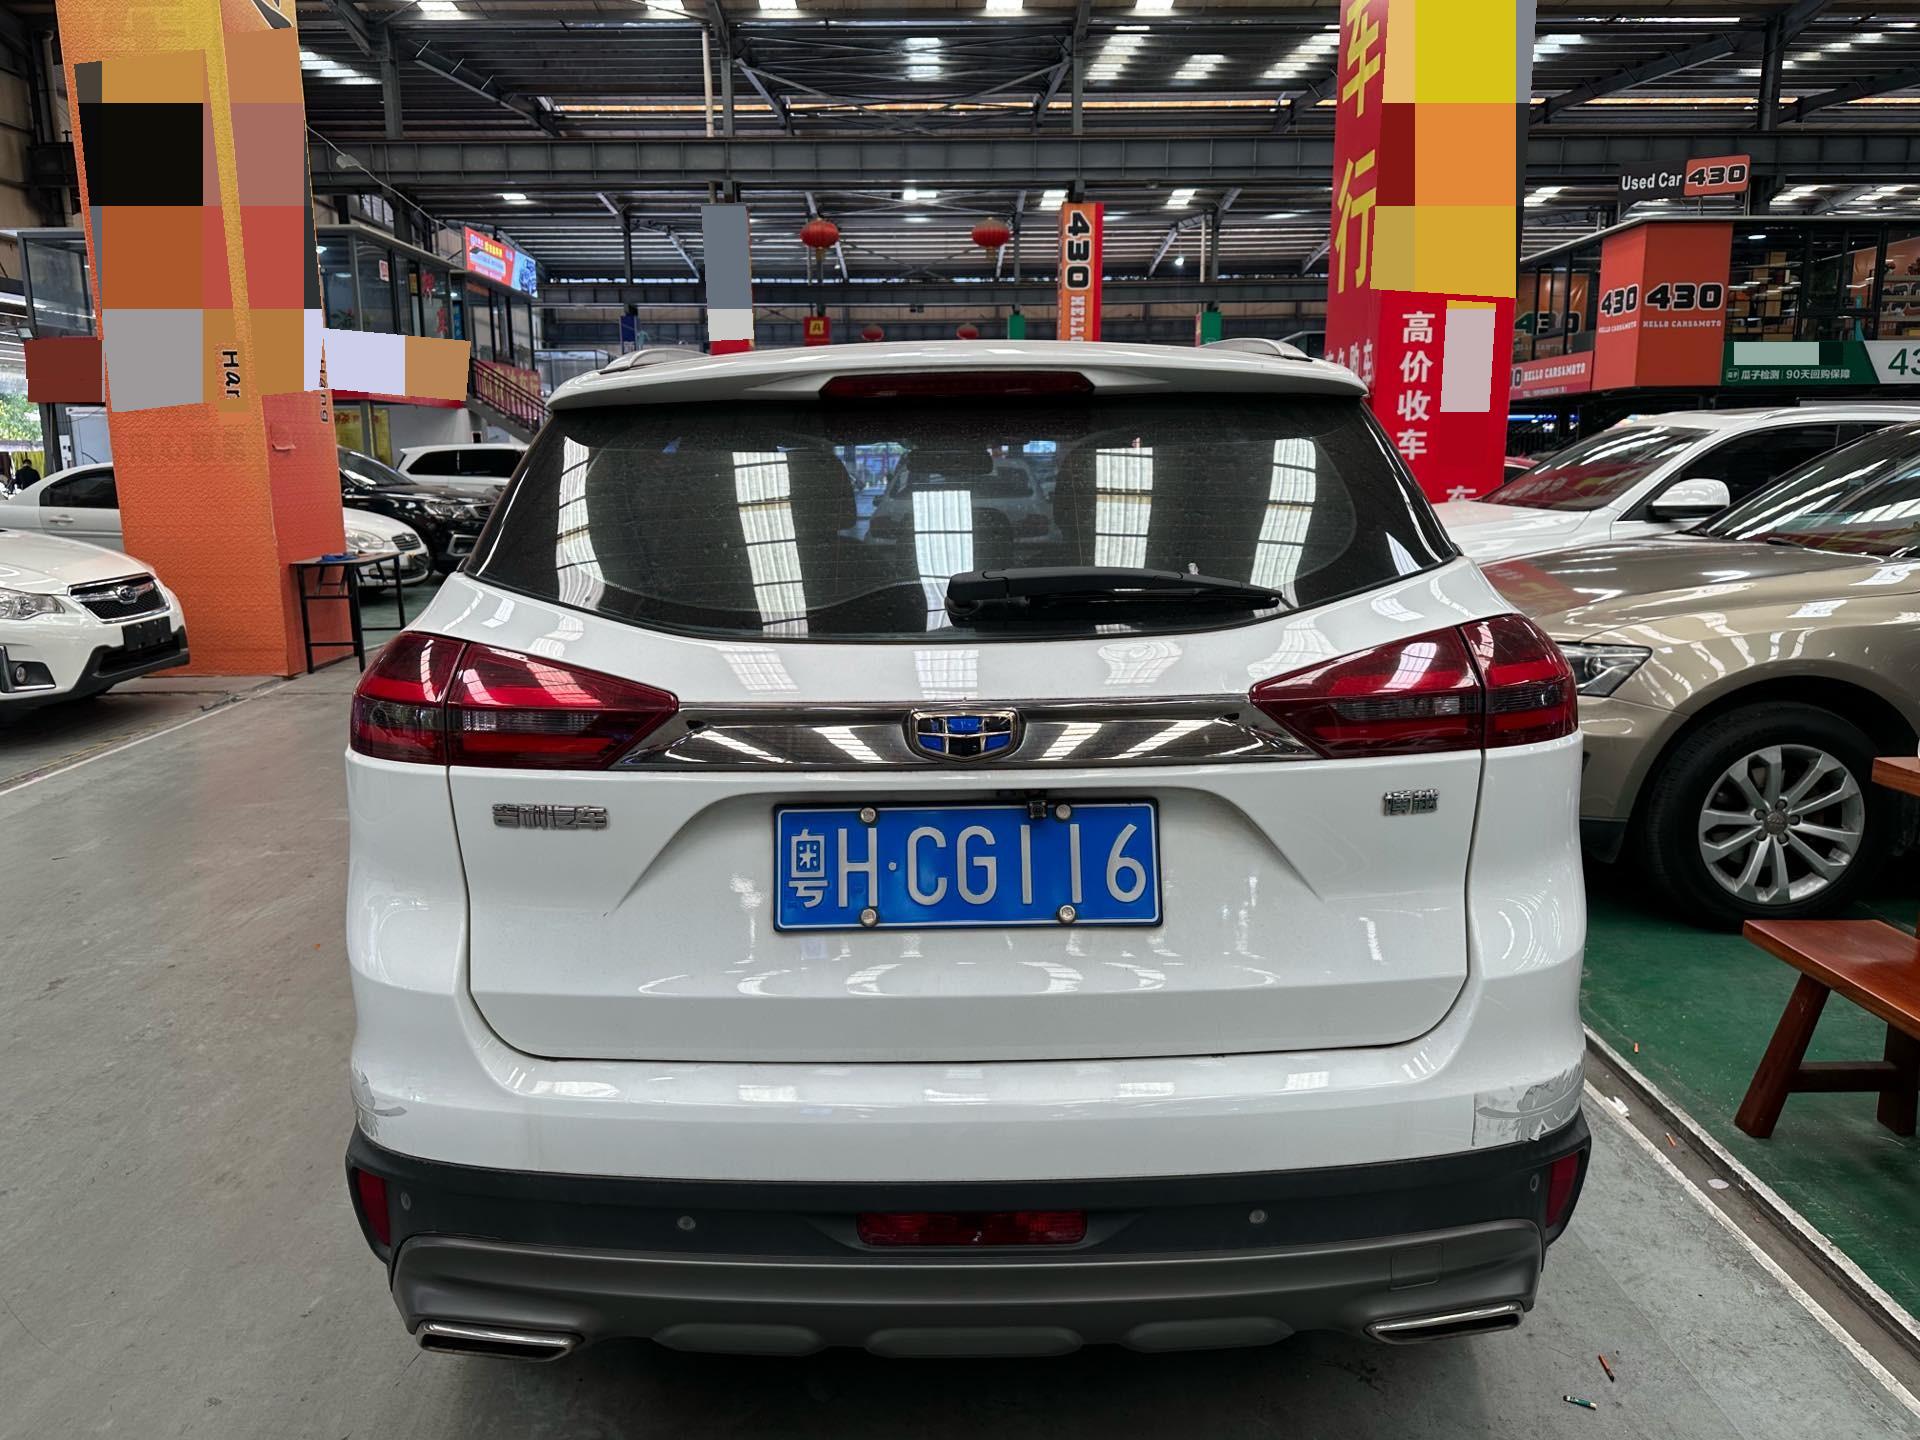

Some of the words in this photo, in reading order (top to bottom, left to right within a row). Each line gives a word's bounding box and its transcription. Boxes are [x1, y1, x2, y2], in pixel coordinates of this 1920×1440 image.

[1621, 173, 1656, 190] Used
[1658, 172, 1682, 188] Car
[1686, 163, 1748, 187] 430
[1066, 210, 1092, 290] 430
[1600, 284, 1639, 317] 430
[1644, 282, 1724, 311] 430
[1643, 320, 1669, 328] HELLO
[1397, 311, 1435, 460] 高价收车
[1741, 369, 1780, 380] 瓜子检测
[1786, 369, 1850, 380] 90天回购保障
